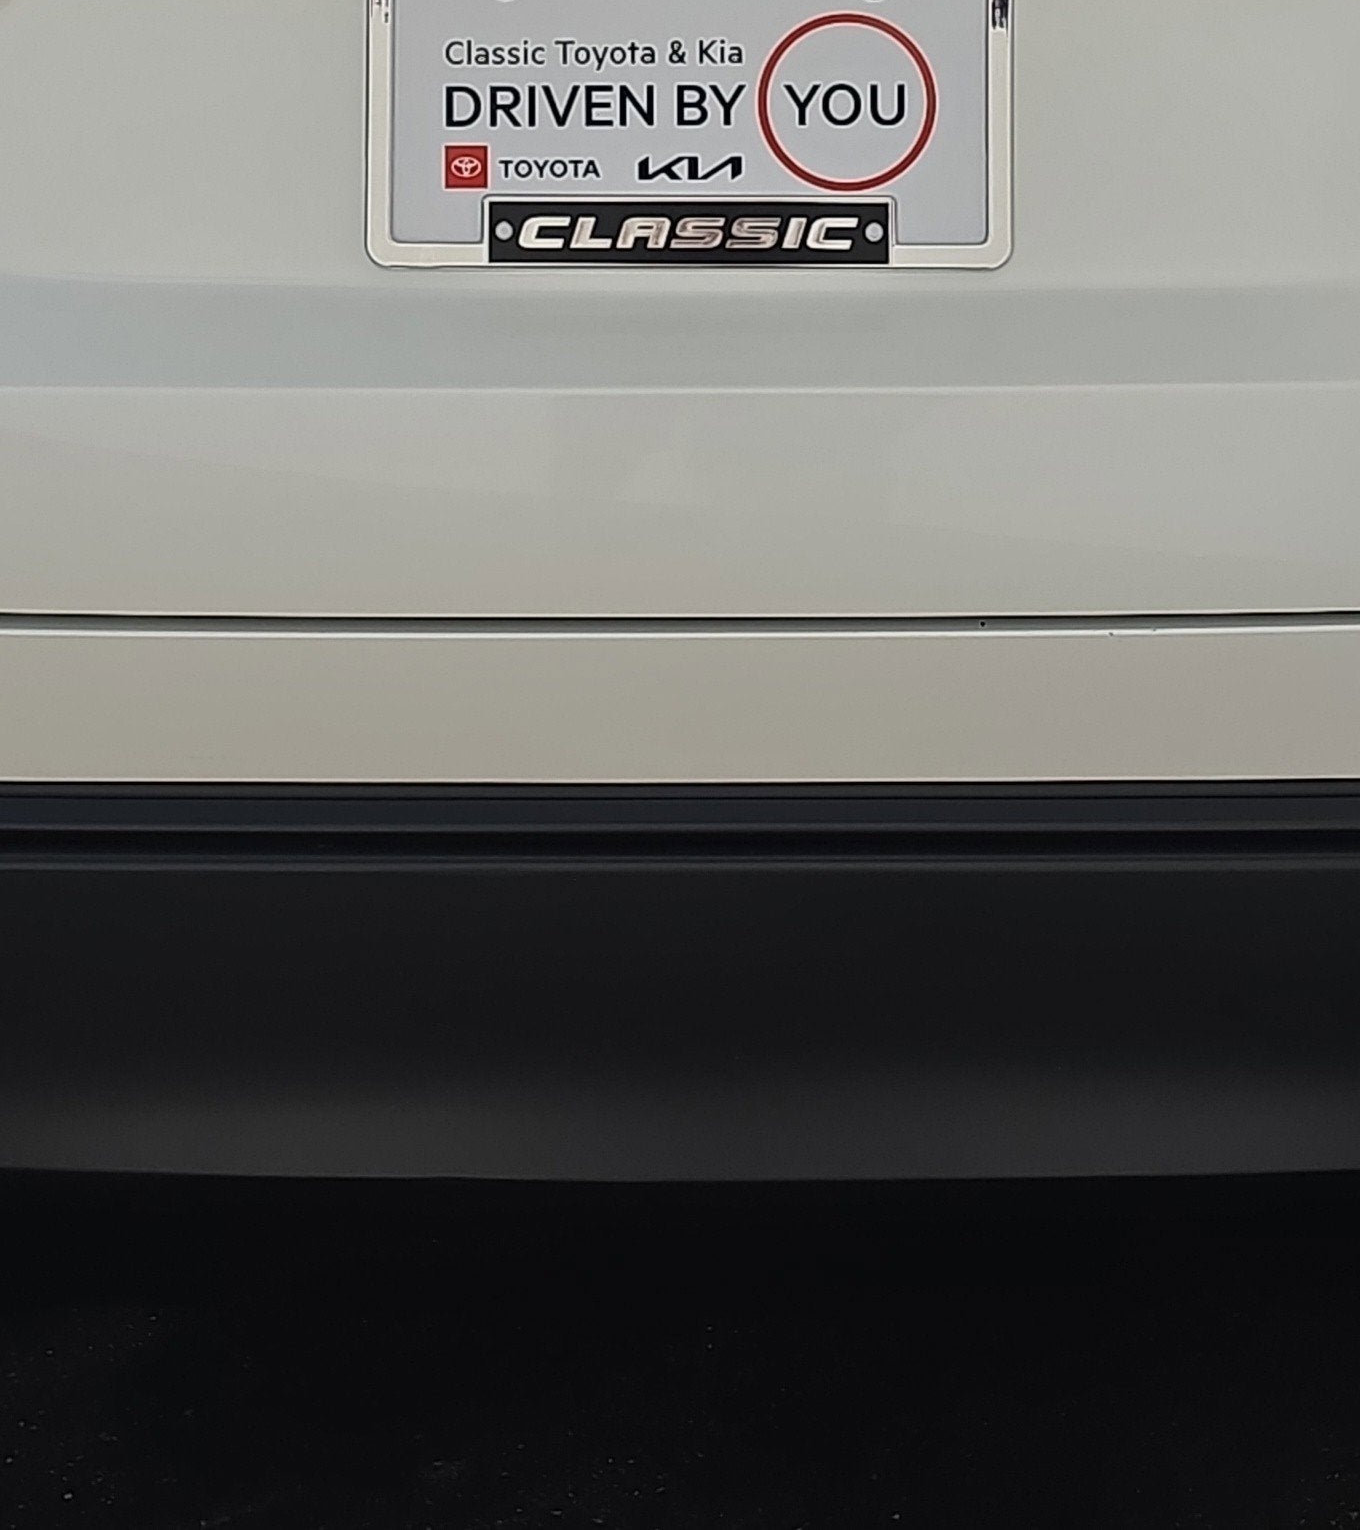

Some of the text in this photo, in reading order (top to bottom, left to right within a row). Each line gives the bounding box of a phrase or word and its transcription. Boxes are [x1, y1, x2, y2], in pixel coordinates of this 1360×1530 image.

[444, 40, 743, 72] Classic Toyota & Kia
[445, 84, 907, 127] DRIVEN BY YOU
[498, 160, 601, 179] TOYOTA
[518, 216, 858, 250] CLASSIC
